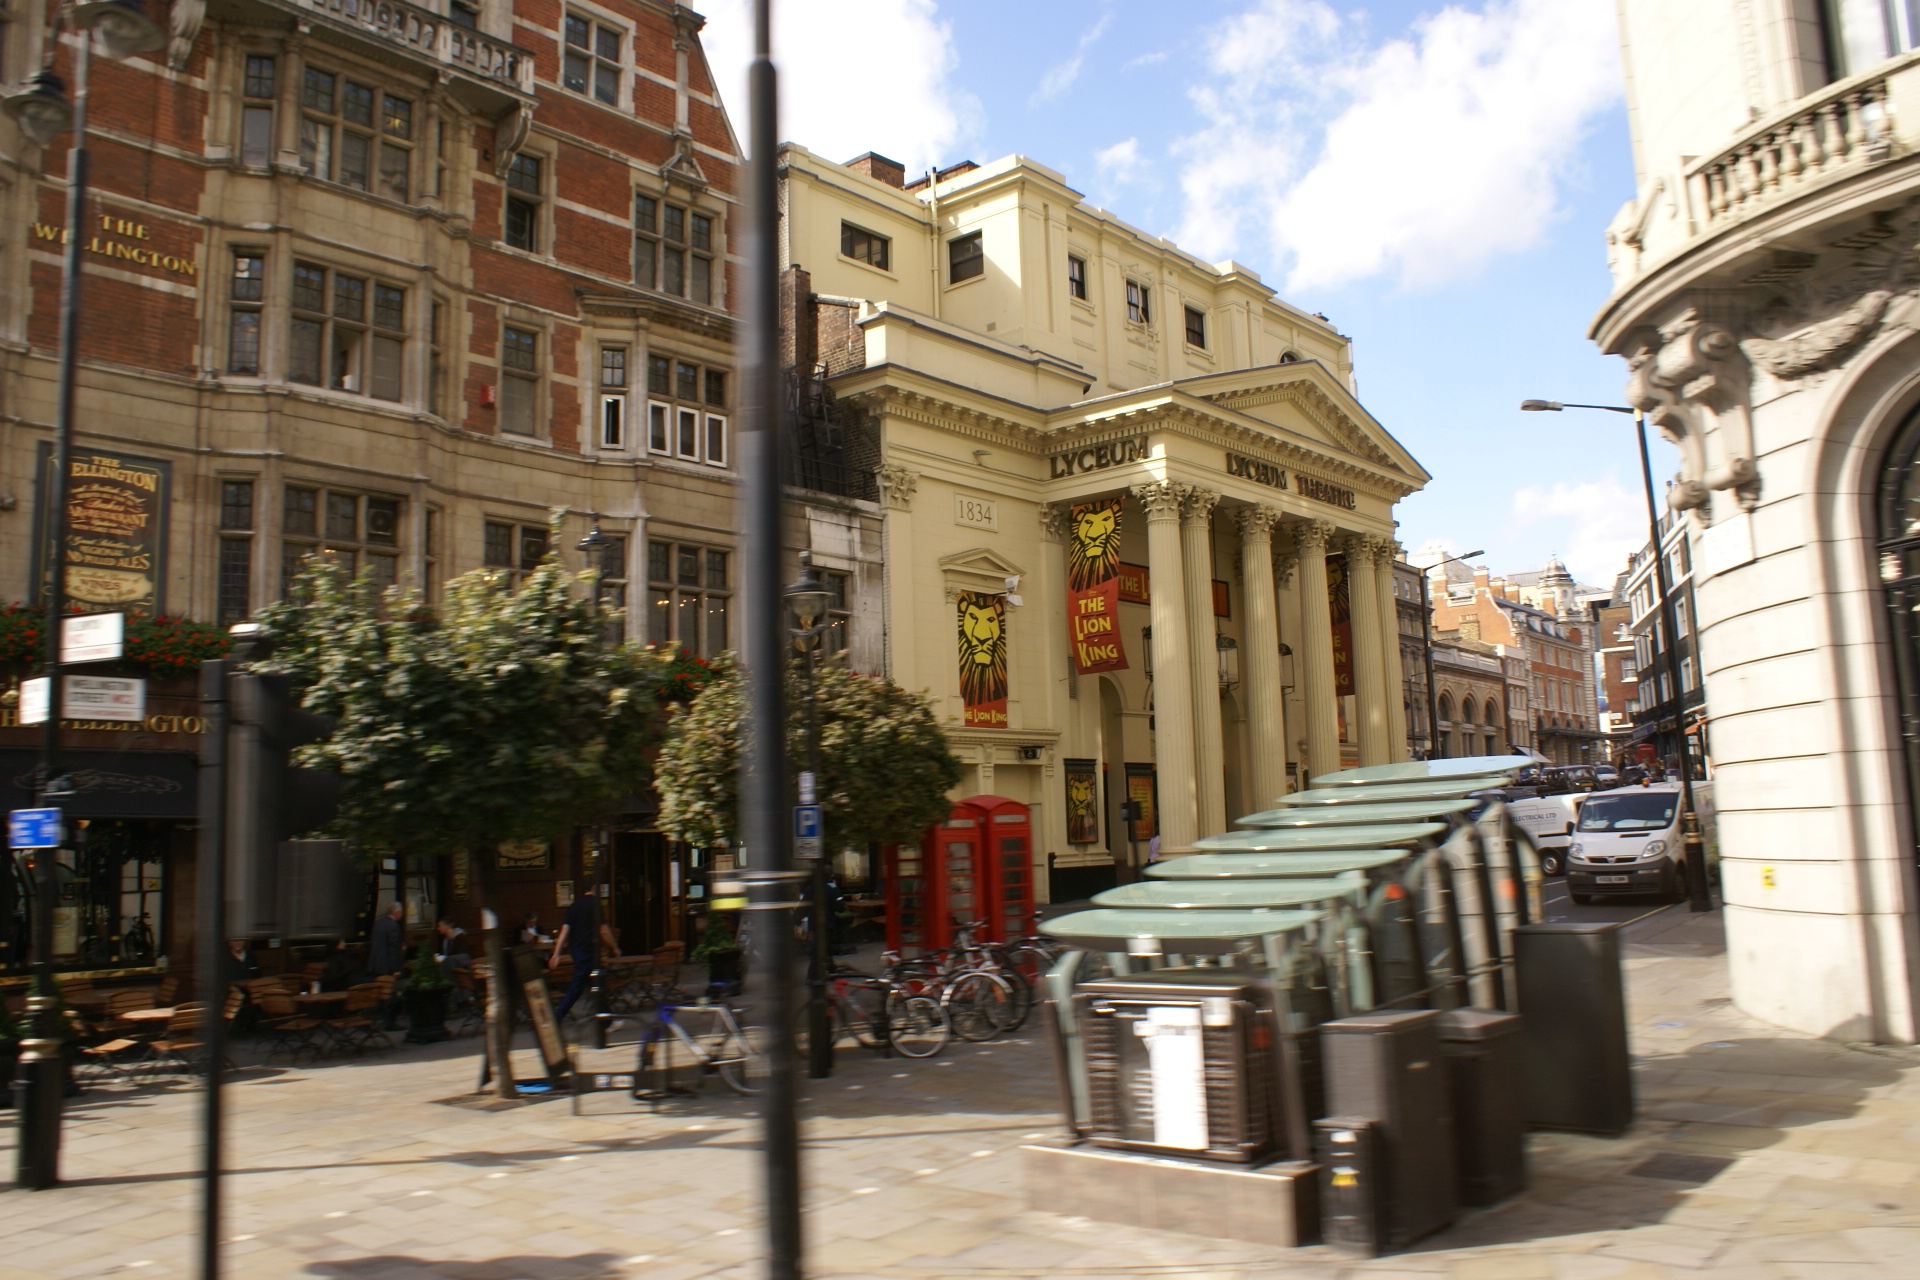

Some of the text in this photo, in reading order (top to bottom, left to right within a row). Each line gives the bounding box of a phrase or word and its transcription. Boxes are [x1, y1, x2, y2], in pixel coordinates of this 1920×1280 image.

[100, 213, 150, 240] THE
[91, 456, 120, 468] THE
[1049, 436, 1149, 478] LYCEUM
[58, 460, 157, 492] ELLINGTON
[1226, 452, 1356, 510] LYCEUM THEATRE
[958, 500, 992, 524] 1834
[1119, 575, 1139, 593] THE
[1079, 596, 1105, 614] THE
[1074, 615, 1112, 641] LION
[1078, 642, 1119, 668] KING
[964, 711, 973, 720] HE
[974, 709, 990, 723] LION
[799, 810, 816, 836] P
